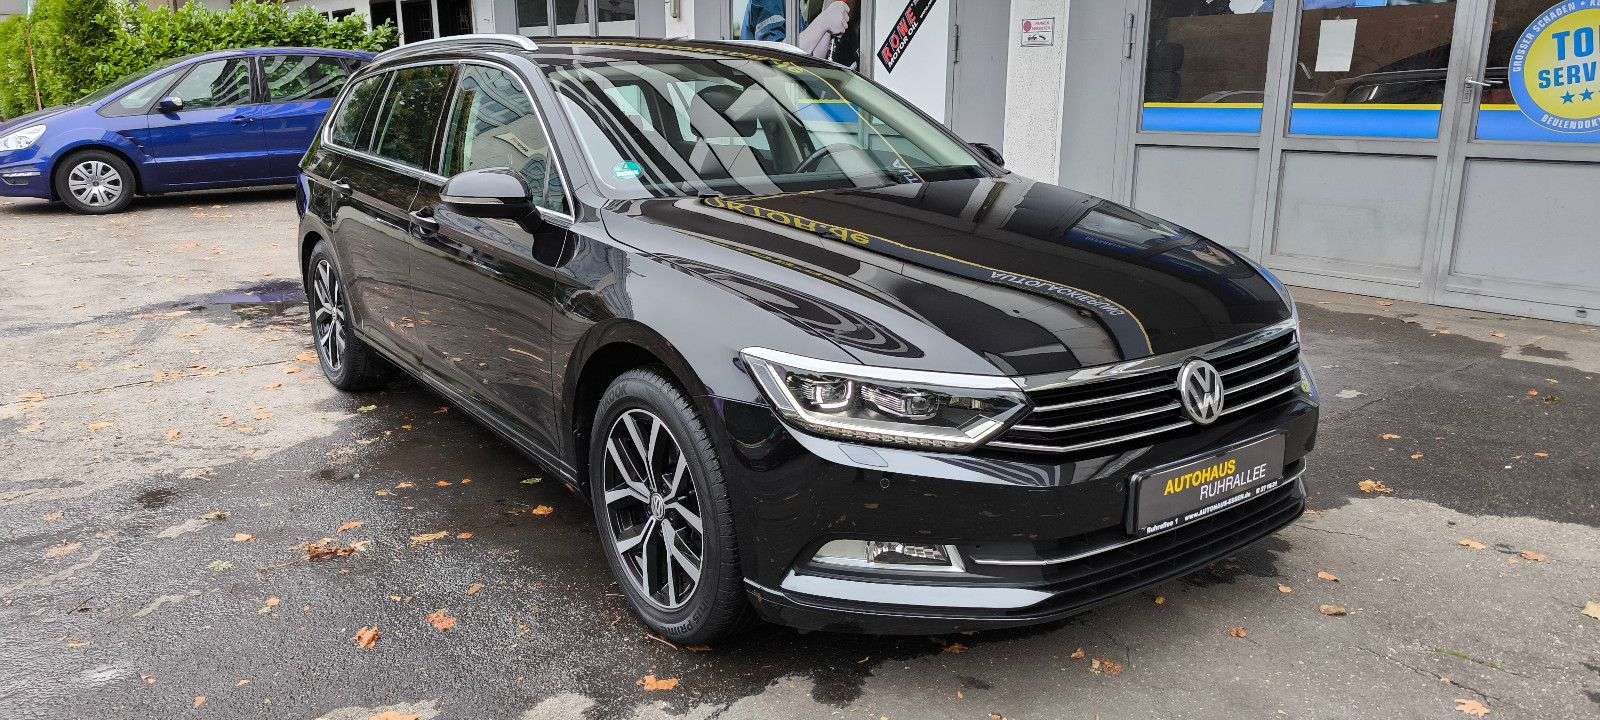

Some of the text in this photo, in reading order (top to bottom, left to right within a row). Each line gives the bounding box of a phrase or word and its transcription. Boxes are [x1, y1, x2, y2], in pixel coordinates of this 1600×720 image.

[888, 22, 919, 68] MOTOR OIL
[1512, 32, 1535, 72] GROSSER
[1533, 2, 1576, 33] SCHADEN
[1552, 26, 1600, 61] TO
[1164, 458, 1237, 496] AUTOHAUS
[1199, 463, 1267, 500] RUHRALLEE
